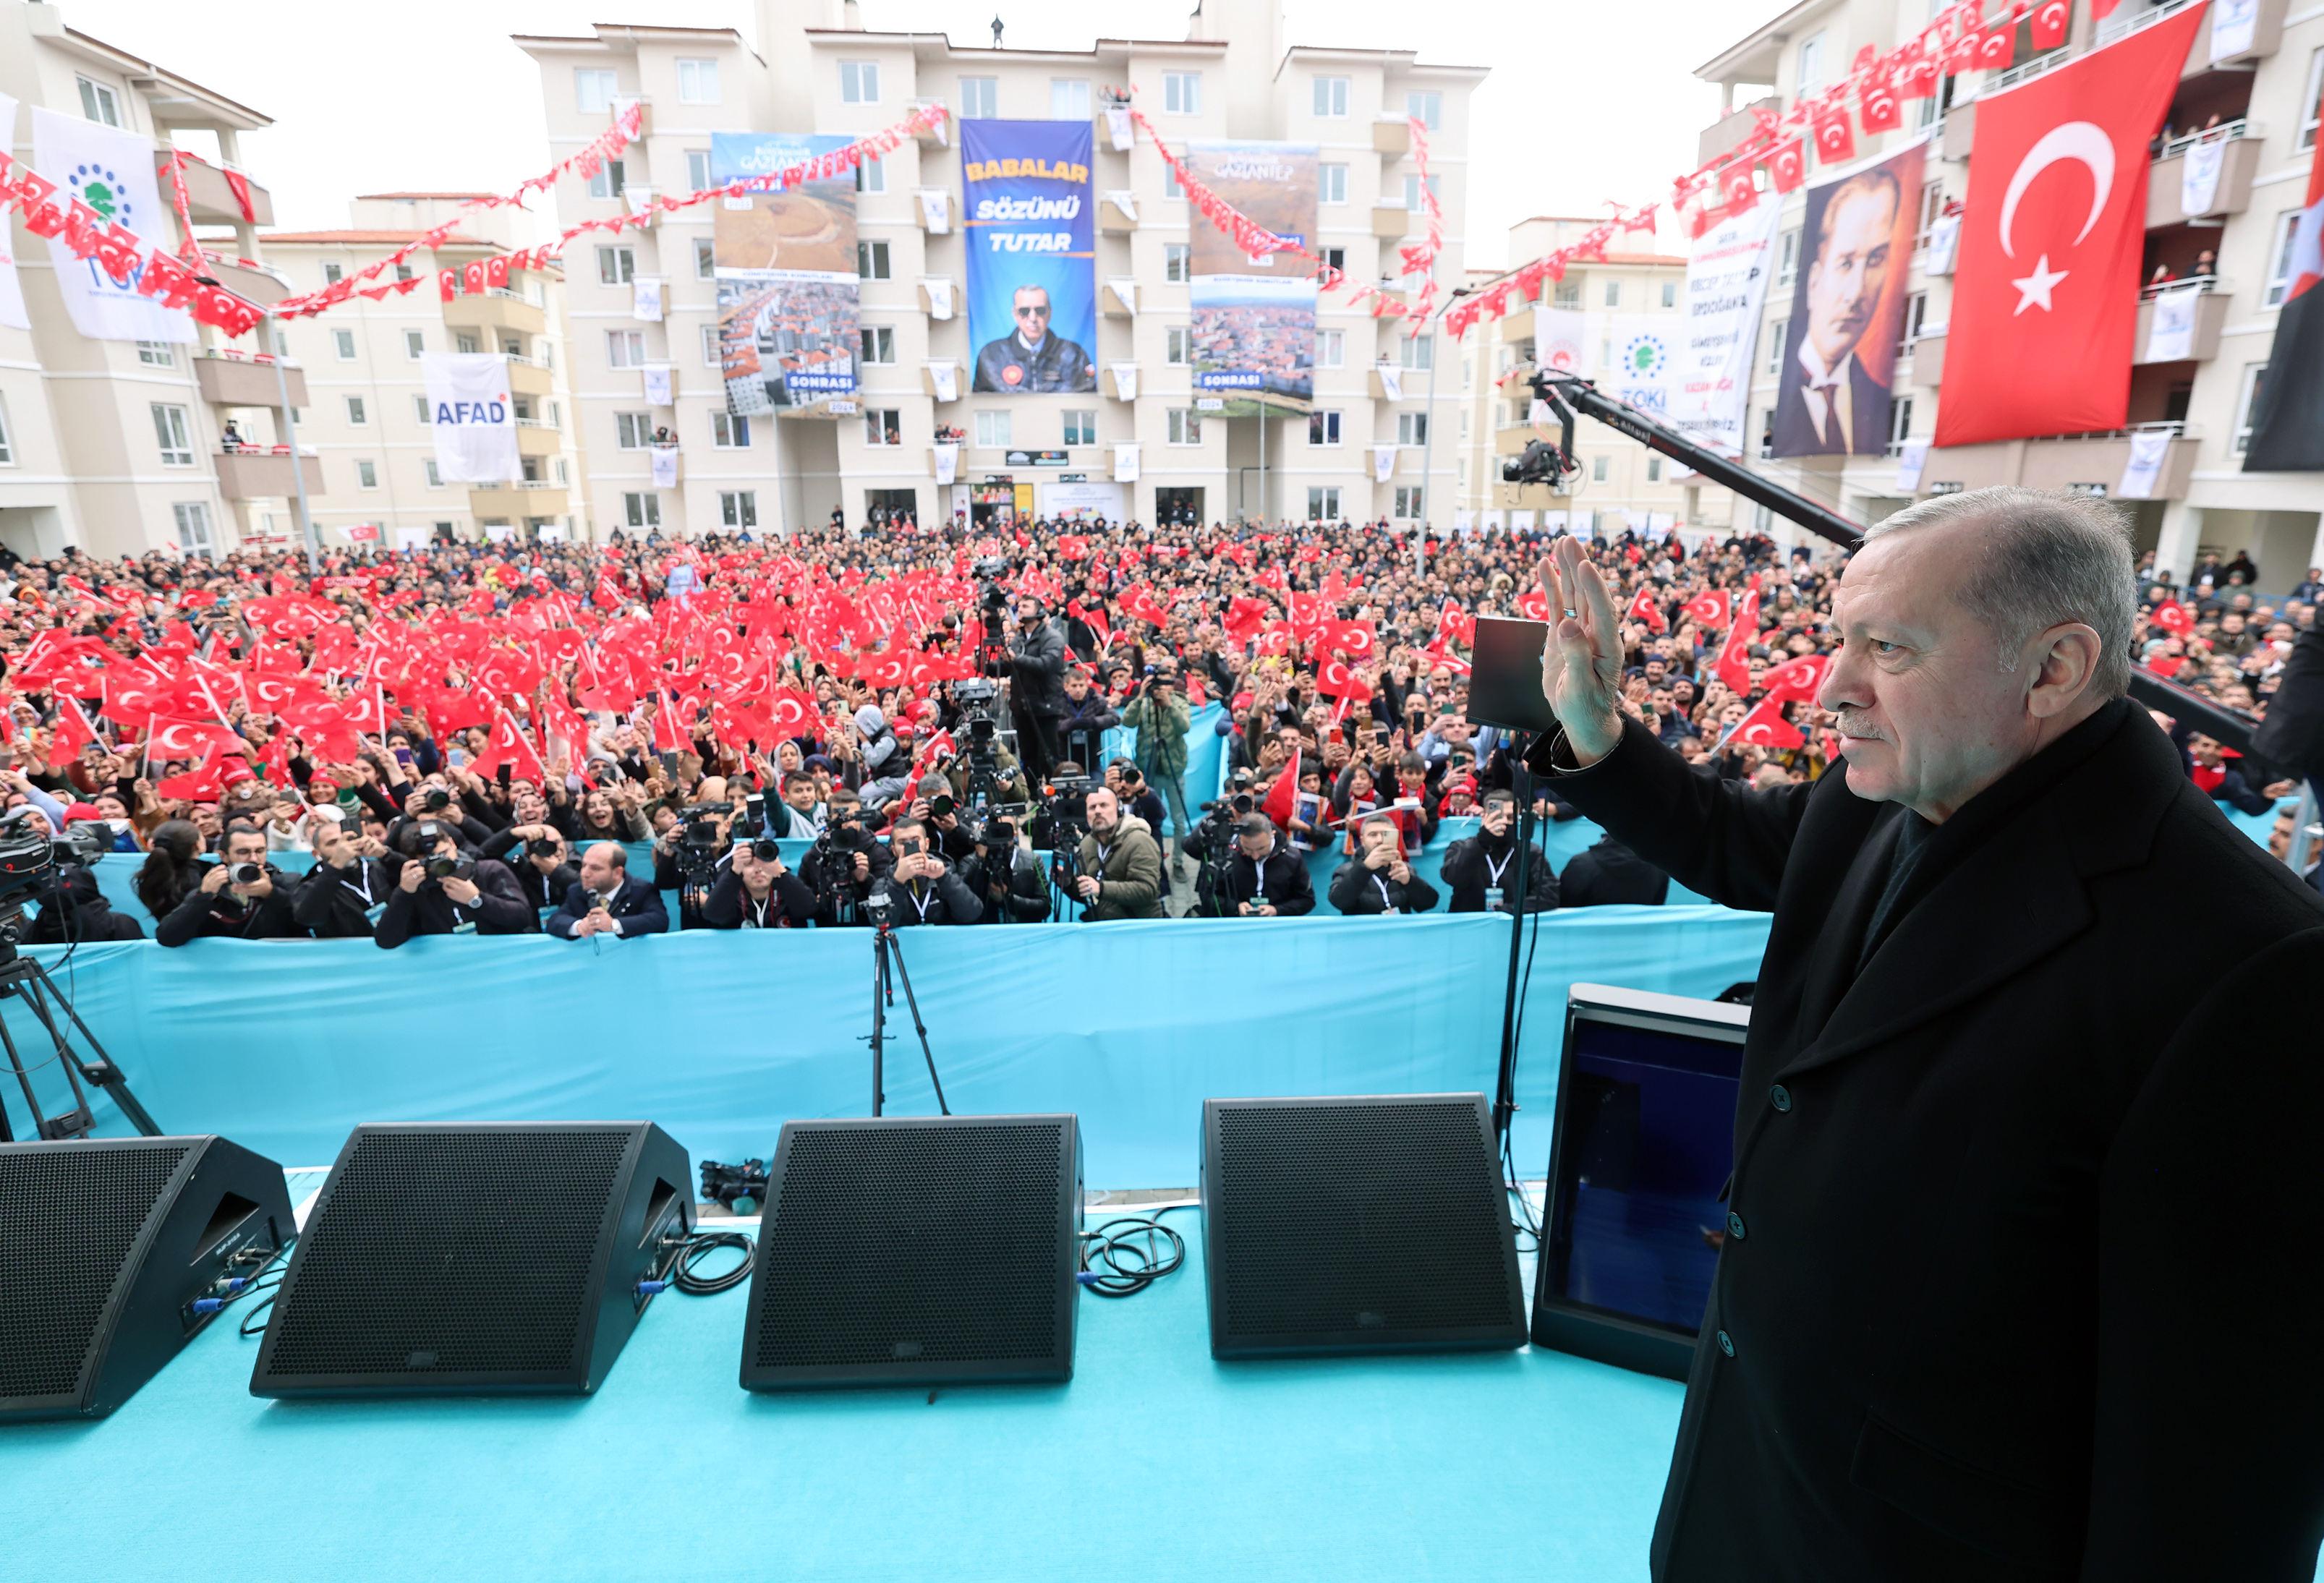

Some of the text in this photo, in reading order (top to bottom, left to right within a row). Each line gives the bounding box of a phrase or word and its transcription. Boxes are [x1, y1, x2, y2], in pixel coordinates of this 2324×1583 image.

[965, 158, 1089, 184] BABALAR
[976, 195, 1081, 220] SÖZÜNÜ
[989, 233, 1073, 252] TUTAR
[790, 375, 853, 389] SONRASI
[1204, 375, 1259, 386] SONRASI
[438, 403, 504, 424] AFAD
